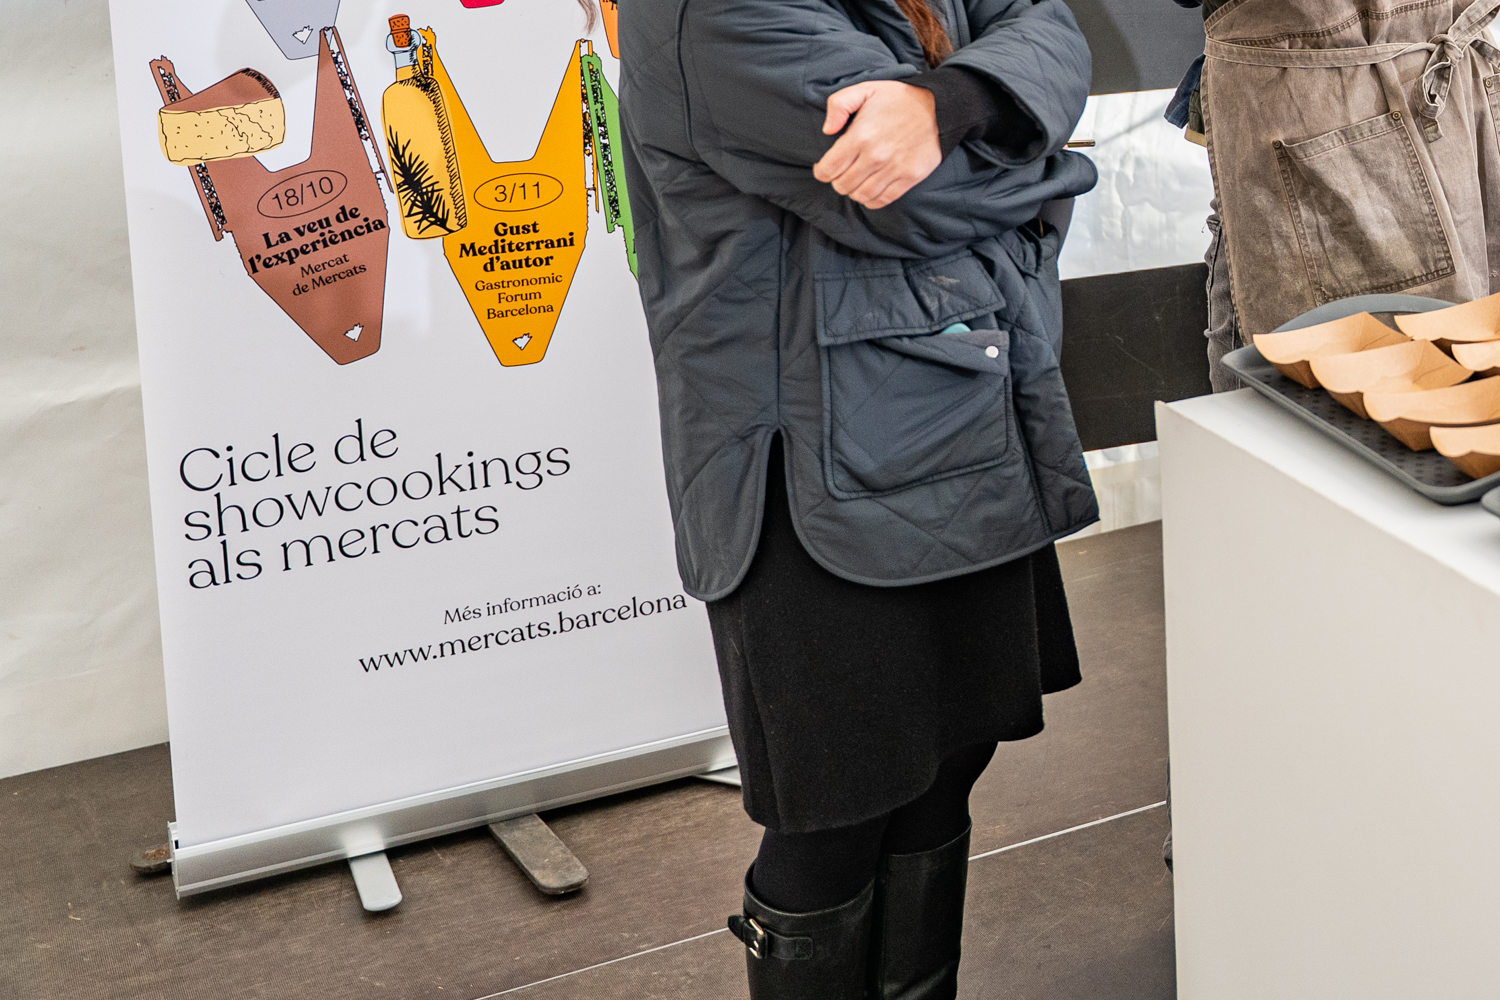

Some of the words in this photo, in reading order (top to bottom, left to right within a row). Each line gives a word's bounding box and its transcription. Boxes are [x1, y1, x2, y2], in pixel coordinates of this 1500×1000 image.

[271, 176, 334, 211] 18/10
[494, 181, 541, 204] 3/11
[262, 231, 293, 250] La
[293, 216, 333, 238] veu
[335, 204, 361, 224] de
[493, 221, 540, 237] Gust
[458, 231, 575, 259] Mediterrani
[292, 283, 310, 296] de
[311, 264, 367, 290] Mercats
[300, 253, 350, 278] Mercat
[474, 272, 563, 292] Gastronomic
[497, 291, 543, 304] Forum
[486, 304, 554, 320] Barcelona
[178, 432, 317, 493] Cicle
[333, 418, 400, 466] de
[183, 445, 572, 542] showcookings
[187, 539, 264, 590] als
[281, 503, 501, 573] mercats
[442, 603, 482, 626] Més
[485, 584, 583, 619] informació
[587, 582, 602, 597] a:
[358, 591, 688, 673] www.mercats.barcelona
